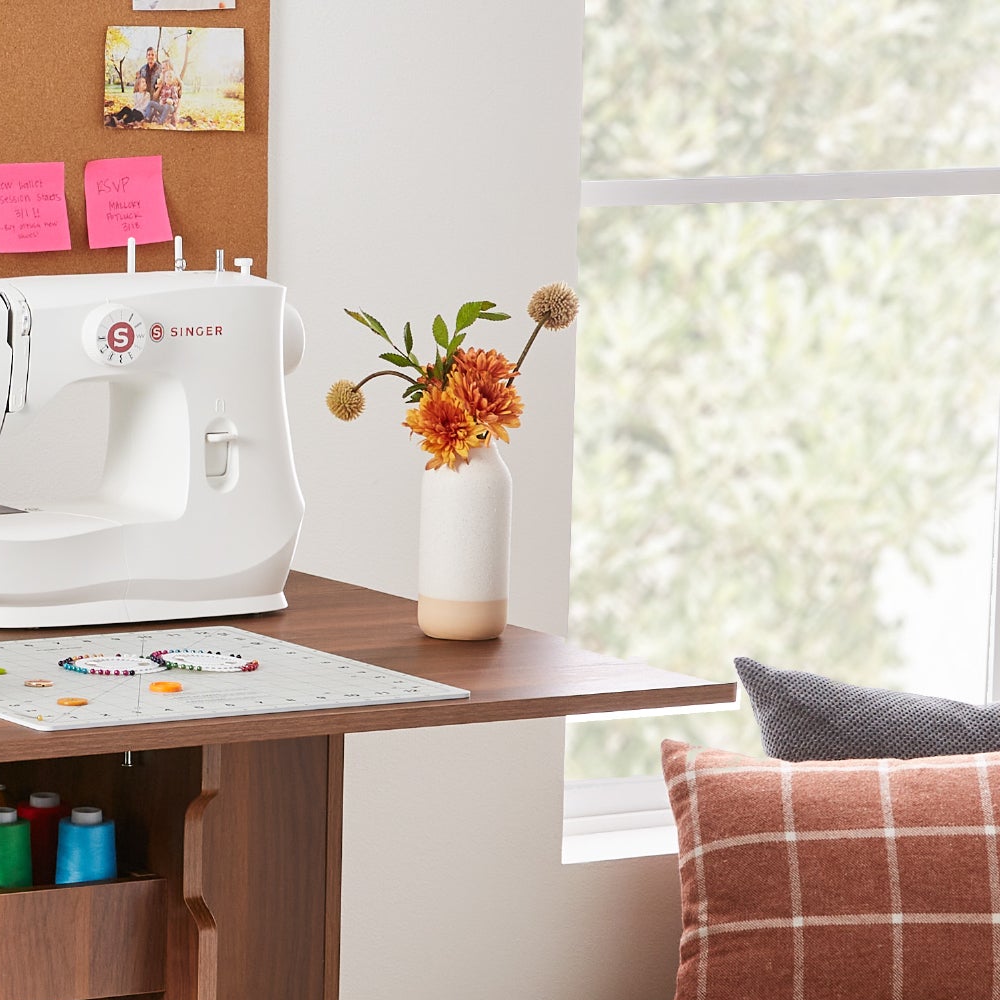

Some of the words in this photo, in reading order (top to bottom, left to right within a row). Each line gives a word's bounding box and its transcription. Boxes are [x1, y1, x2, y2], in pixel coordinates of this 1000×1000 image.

[96, 176, 130, 195] RSVP
[113, 327, 129, 348] S
[170, 326, 223, 337] SINGER
